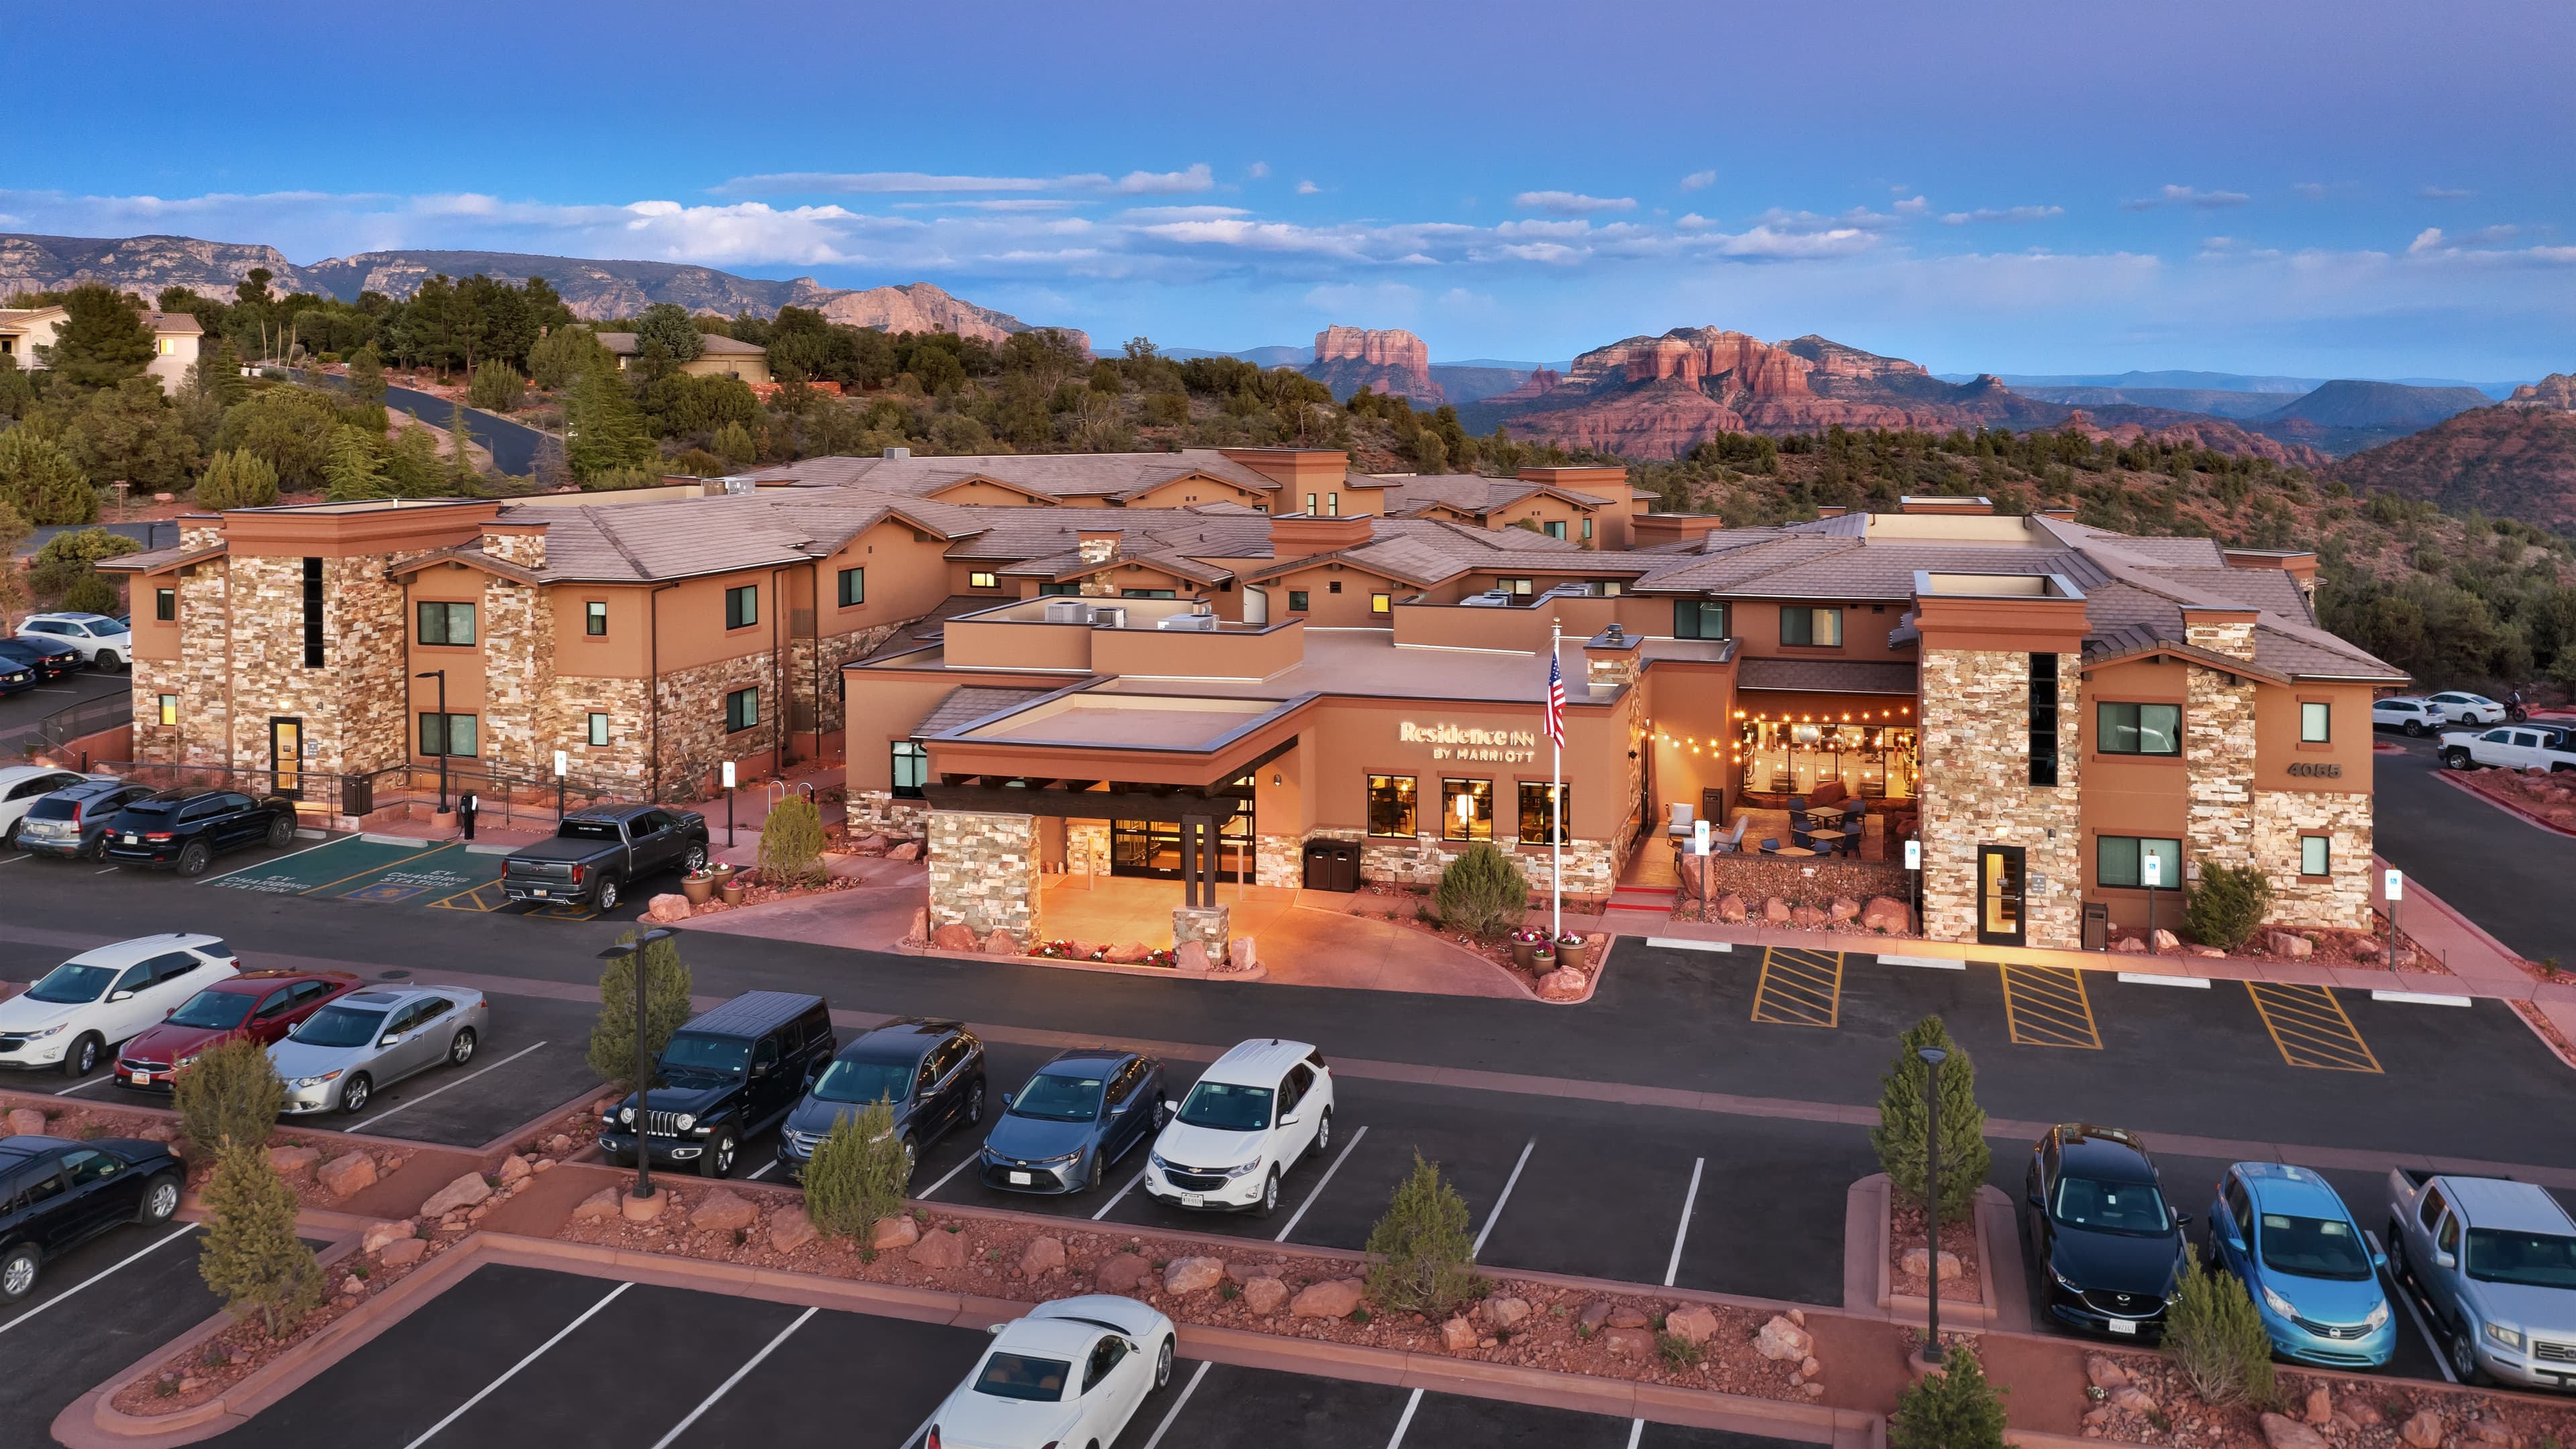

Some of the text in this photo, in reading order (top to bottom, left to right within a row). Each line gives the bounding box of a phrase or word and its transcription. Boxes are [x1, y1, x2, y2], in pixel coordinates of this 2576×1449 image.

[1400, 722, 1535, 747] Residence INN
[1434, 748, 1535, 763] BY MARRIOTT
[2287, 763, 2341, 778] 4055
[223, 877, 311, 889] CHARGING
[380, 877, 455, 886] STATION
[387, 872, 470, 882] CHARGING
[215, 882, 291, 893] STATION
